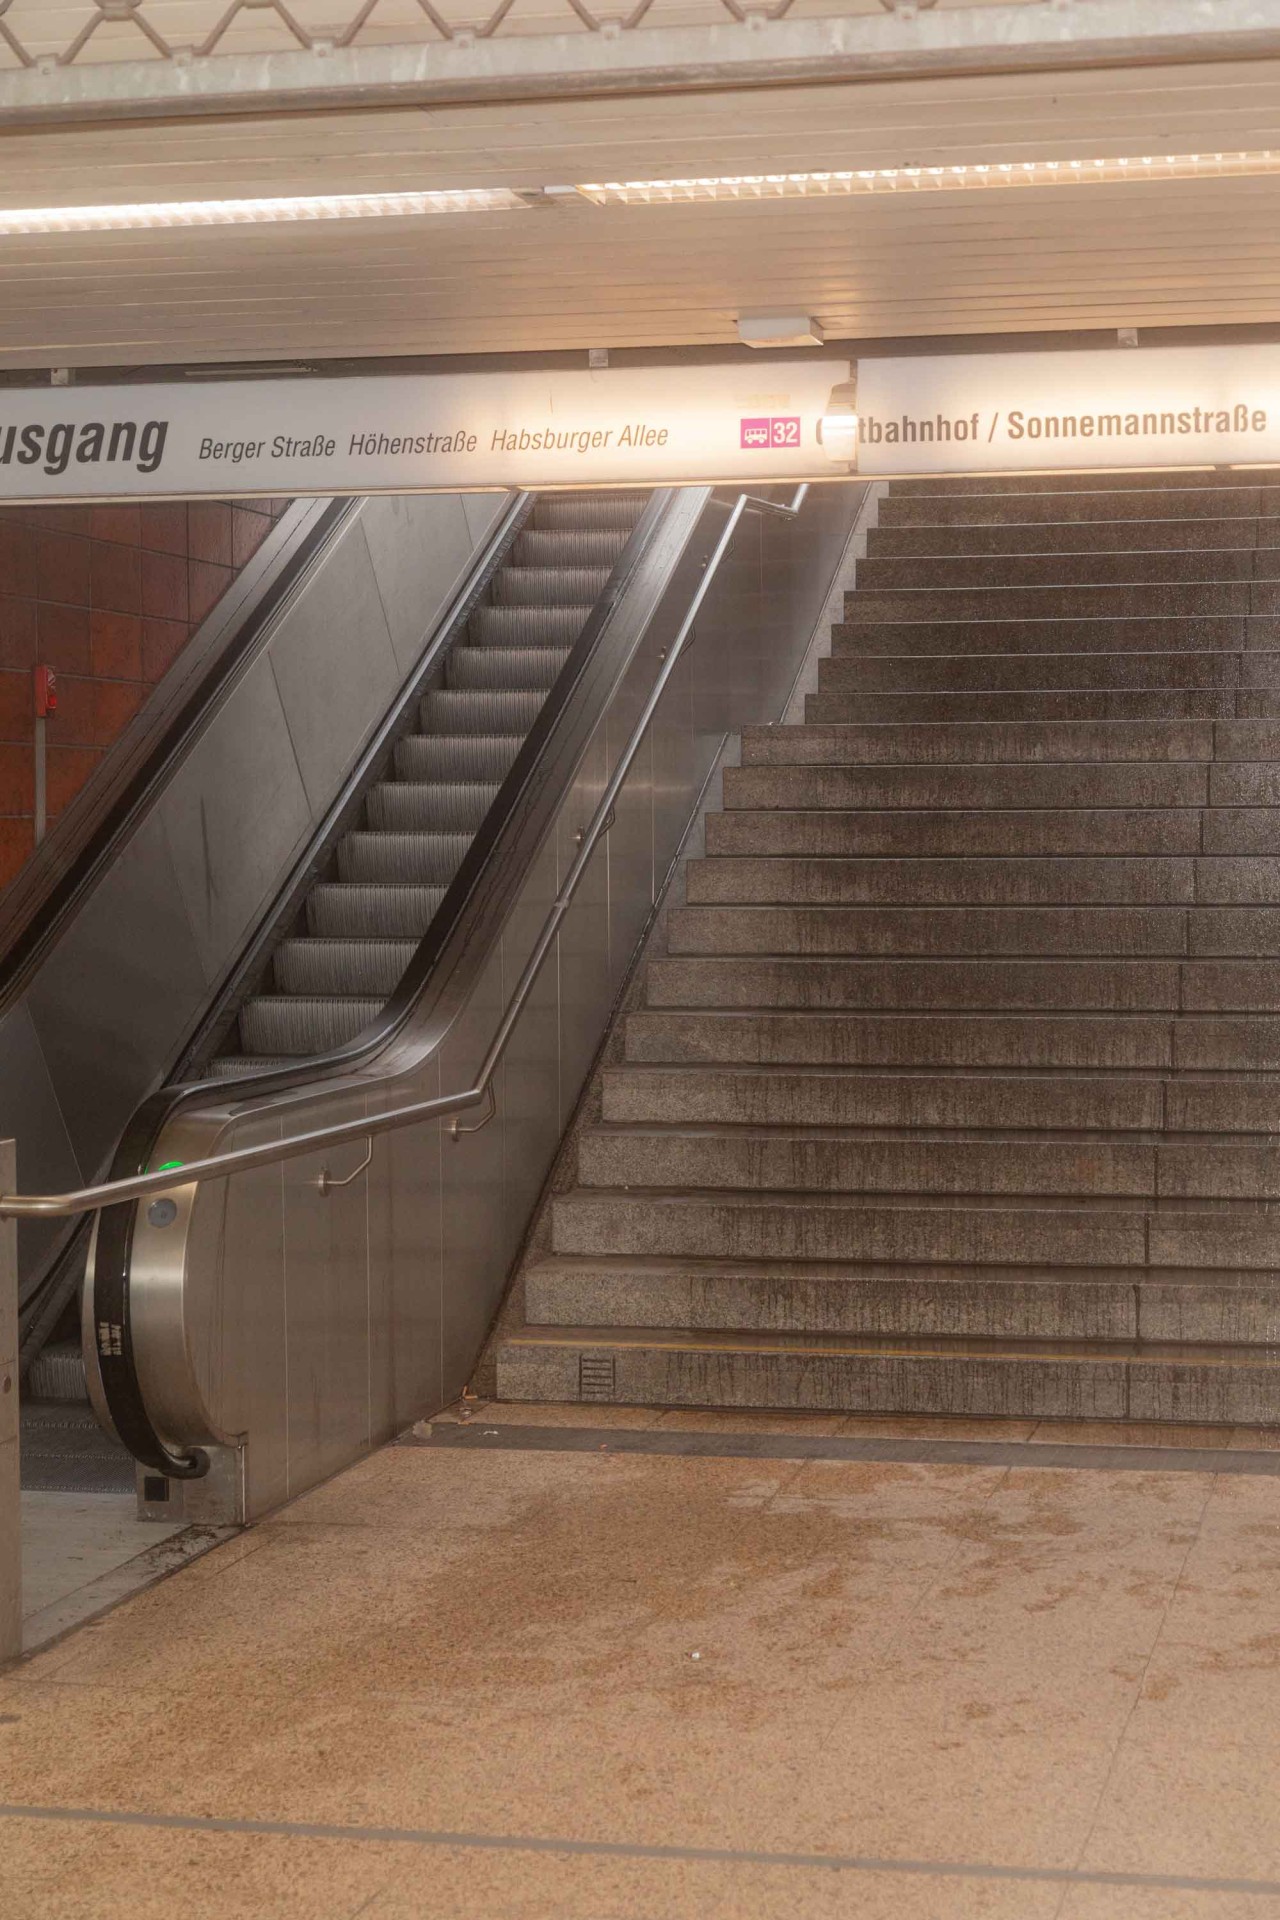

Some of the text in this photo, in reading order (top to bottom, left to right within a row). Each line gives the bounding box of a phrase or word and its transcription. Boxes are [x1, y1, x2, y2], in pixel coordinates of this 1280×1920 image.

[199, 424, 669, 464] Berger Straße Höhenstraße Habsburger Allee
[773, 421, 799, 445] 32
[816, 413, 980, 446] tbahnhof
[1007, 403, 1267, 440] Sonnemannstraße
